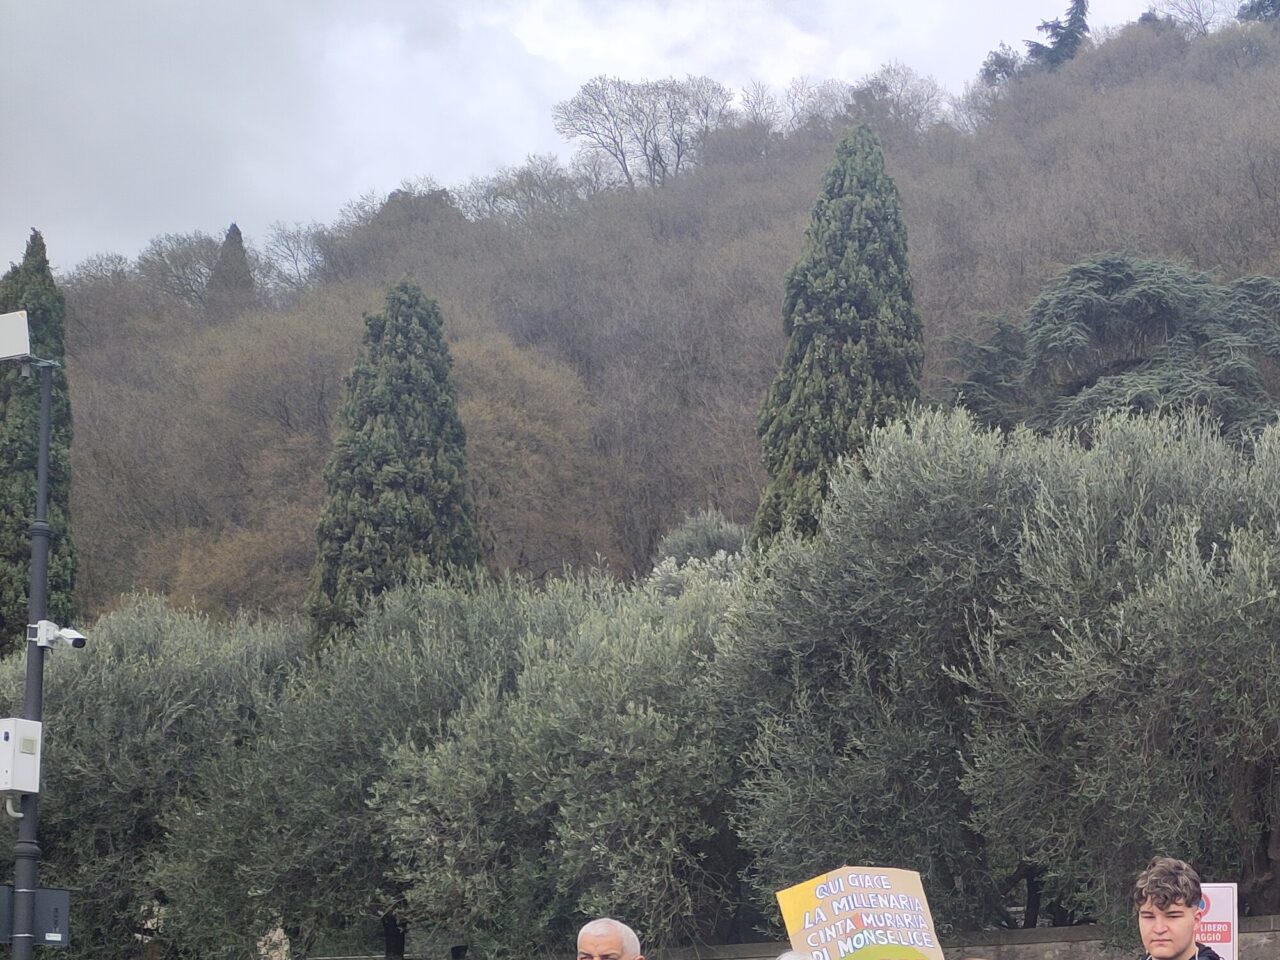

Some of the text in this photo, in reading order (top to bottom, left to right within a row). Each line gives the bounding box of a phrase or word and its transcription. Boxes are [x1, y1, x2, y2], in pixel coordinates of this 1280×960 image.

[815, 873, 892, 900] QUI GIACE
[803, 892, 925, 930] LA MILLENARIA
[806, 911, 930, 948] CINTA MURARIA
[1200, 923, 1229, 932] LIBERO
[837, 929, 936, 959] MONSELICE
